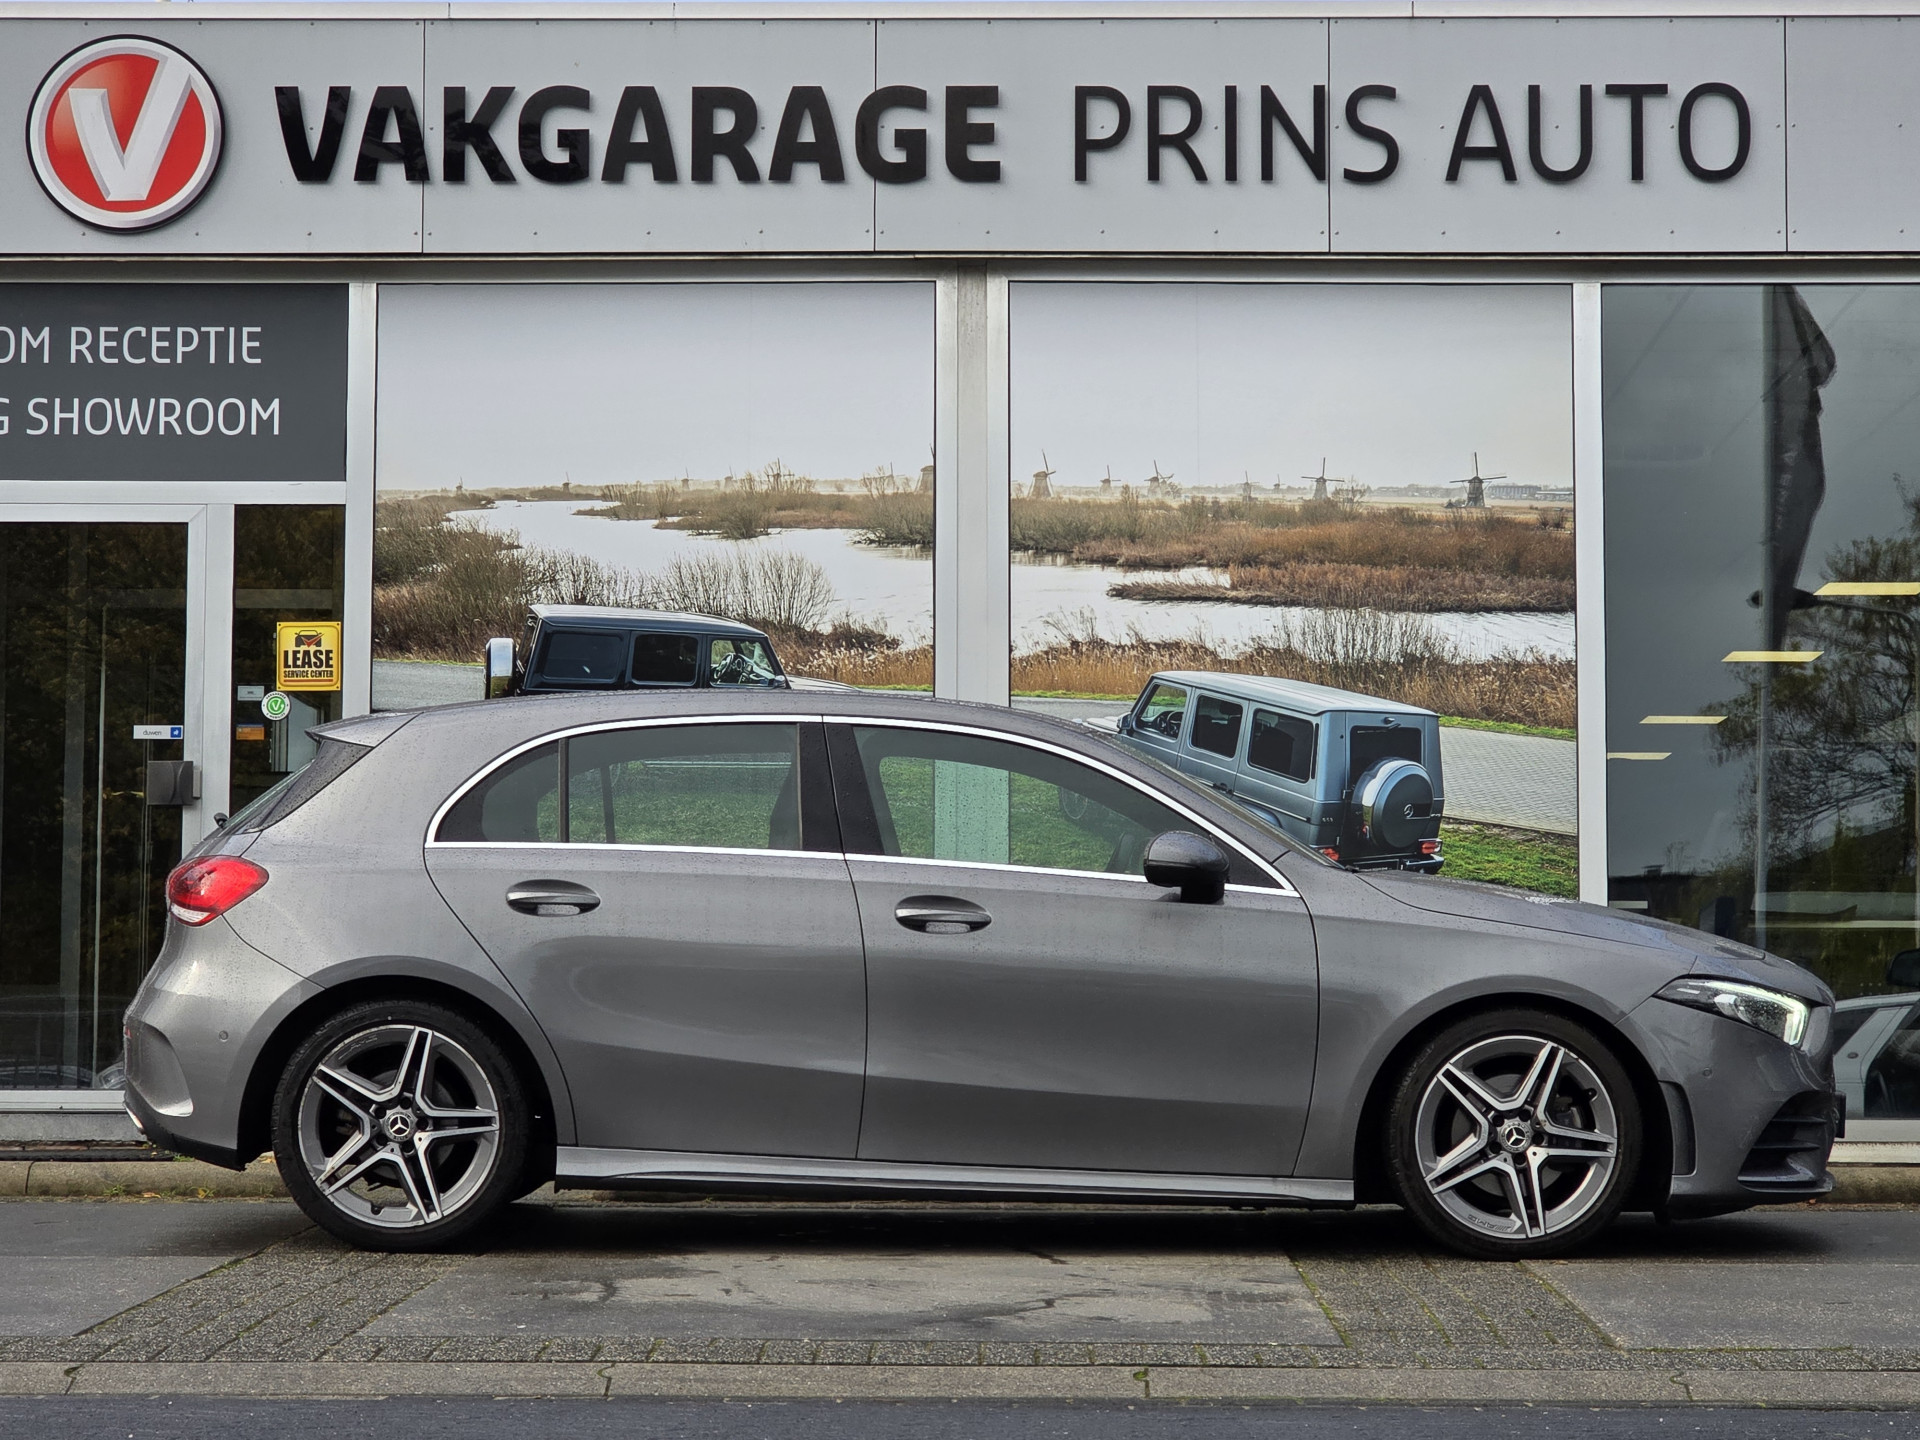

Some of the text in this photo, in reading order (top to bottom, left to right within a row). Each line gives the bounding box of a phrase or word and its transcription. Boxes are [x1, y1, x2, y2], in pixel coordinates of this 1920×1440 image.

[274, 82, 1751, 186] VAKGARAGE PRINS AUTO
[70, 326, 262, 364] RECEPTIE
[26, 397, 280, 436] SHOWROOM
[283, 649, 334, 669] LEASE
[283, 669, 334, 678] SERVICE CENTER
